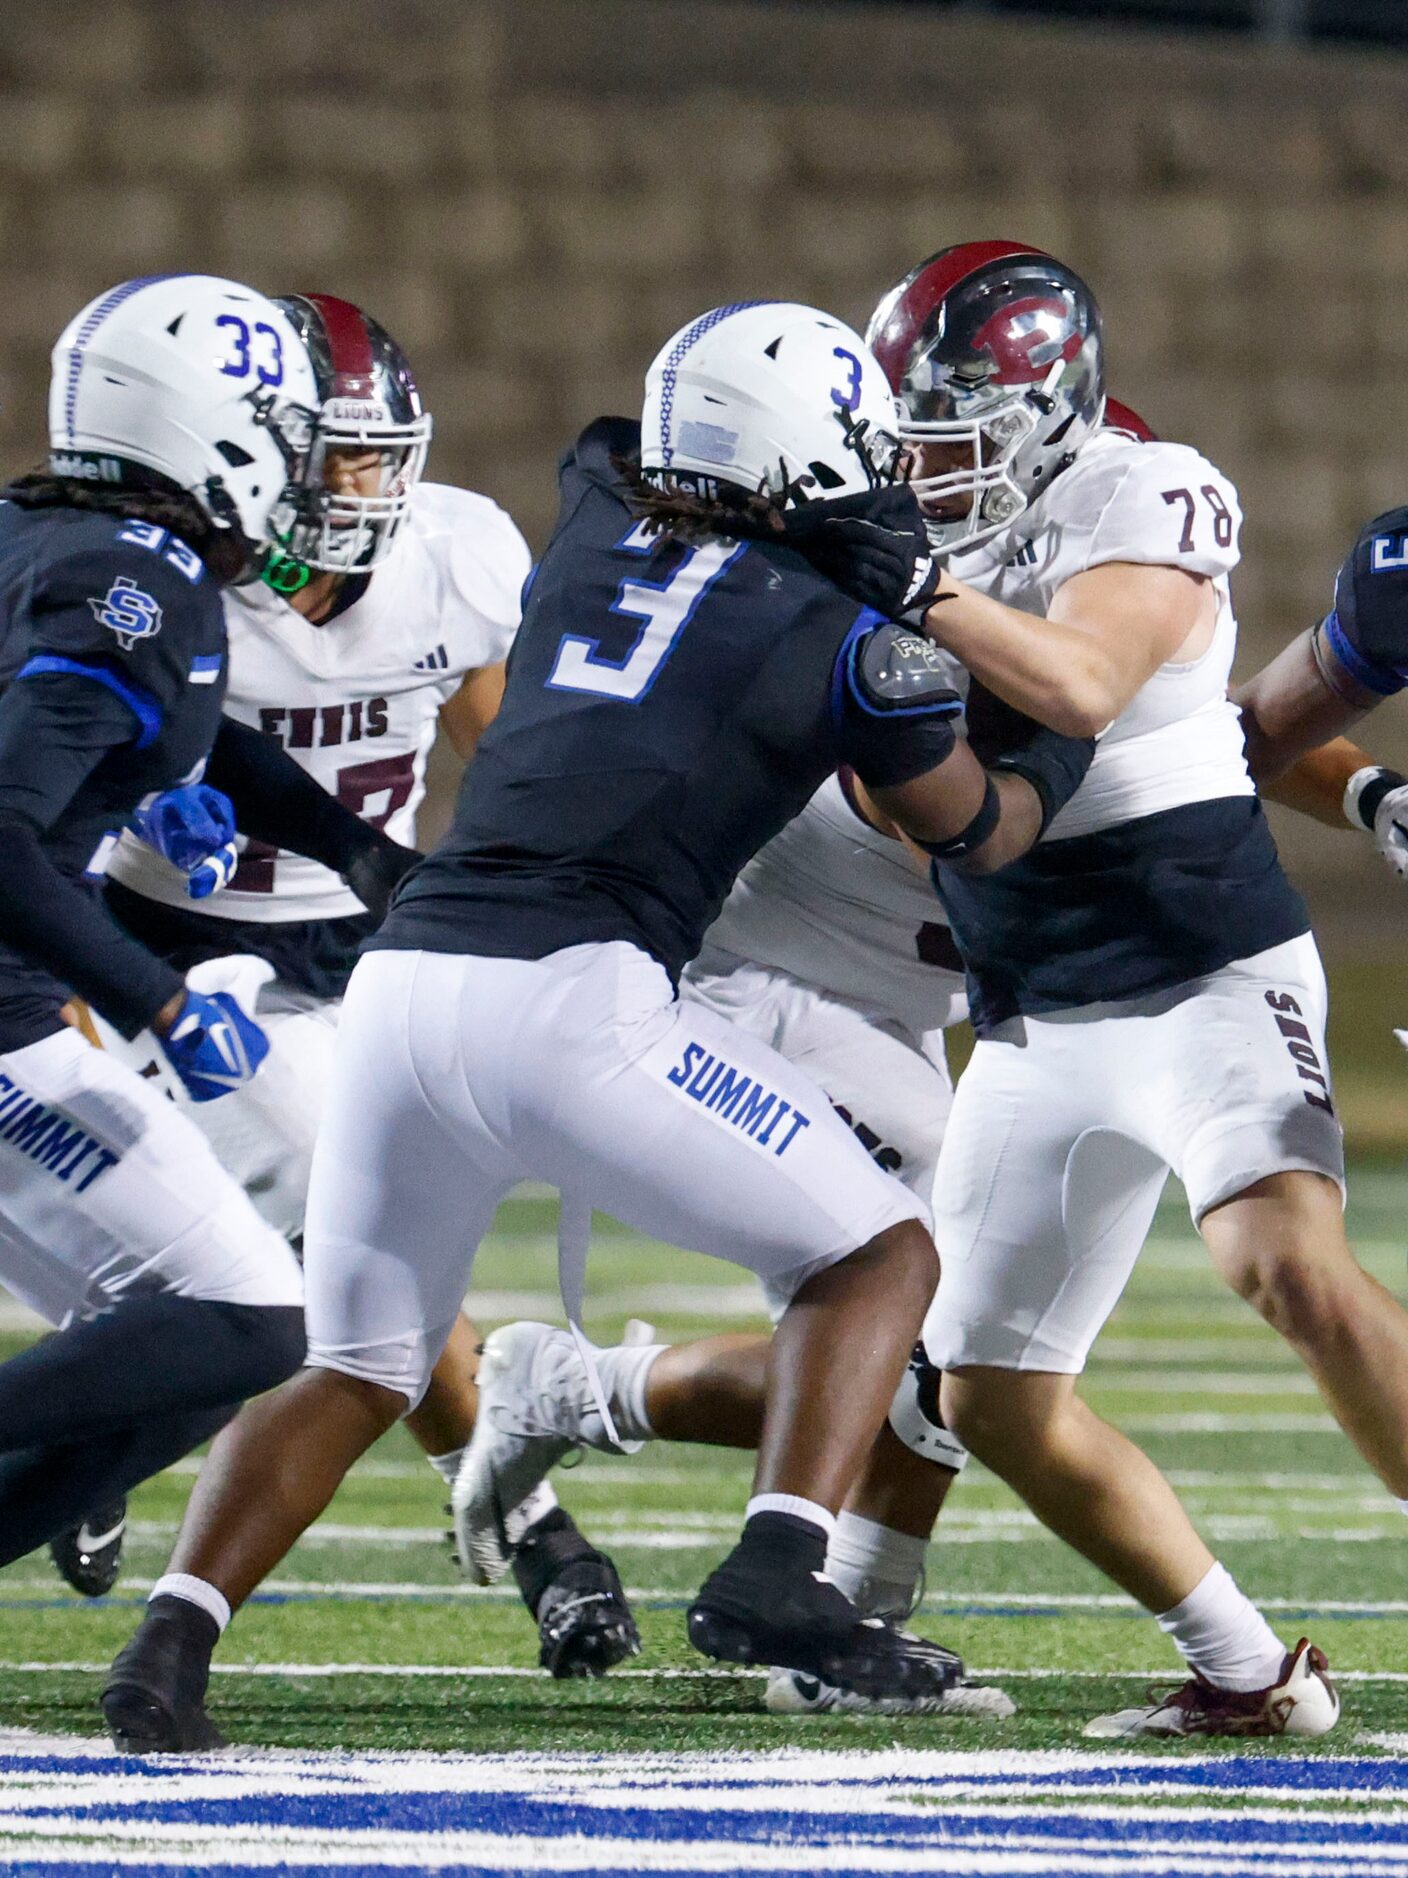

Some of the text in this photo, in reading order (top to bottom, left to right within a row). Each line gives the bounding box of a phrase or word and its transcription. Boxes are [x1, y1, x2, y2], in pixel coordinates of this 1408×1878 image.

[214, 313, 282, 387] 33
[830, 346, 862, 411] 3
[116, 518, 205, 586] 33
[1160, 484, 1232, 554] 78
[544, 516, 750, 704] 3
[1264, 989, 1334, 1118] LIONS
[667, 1041, 811, 1157] SUMMIT
